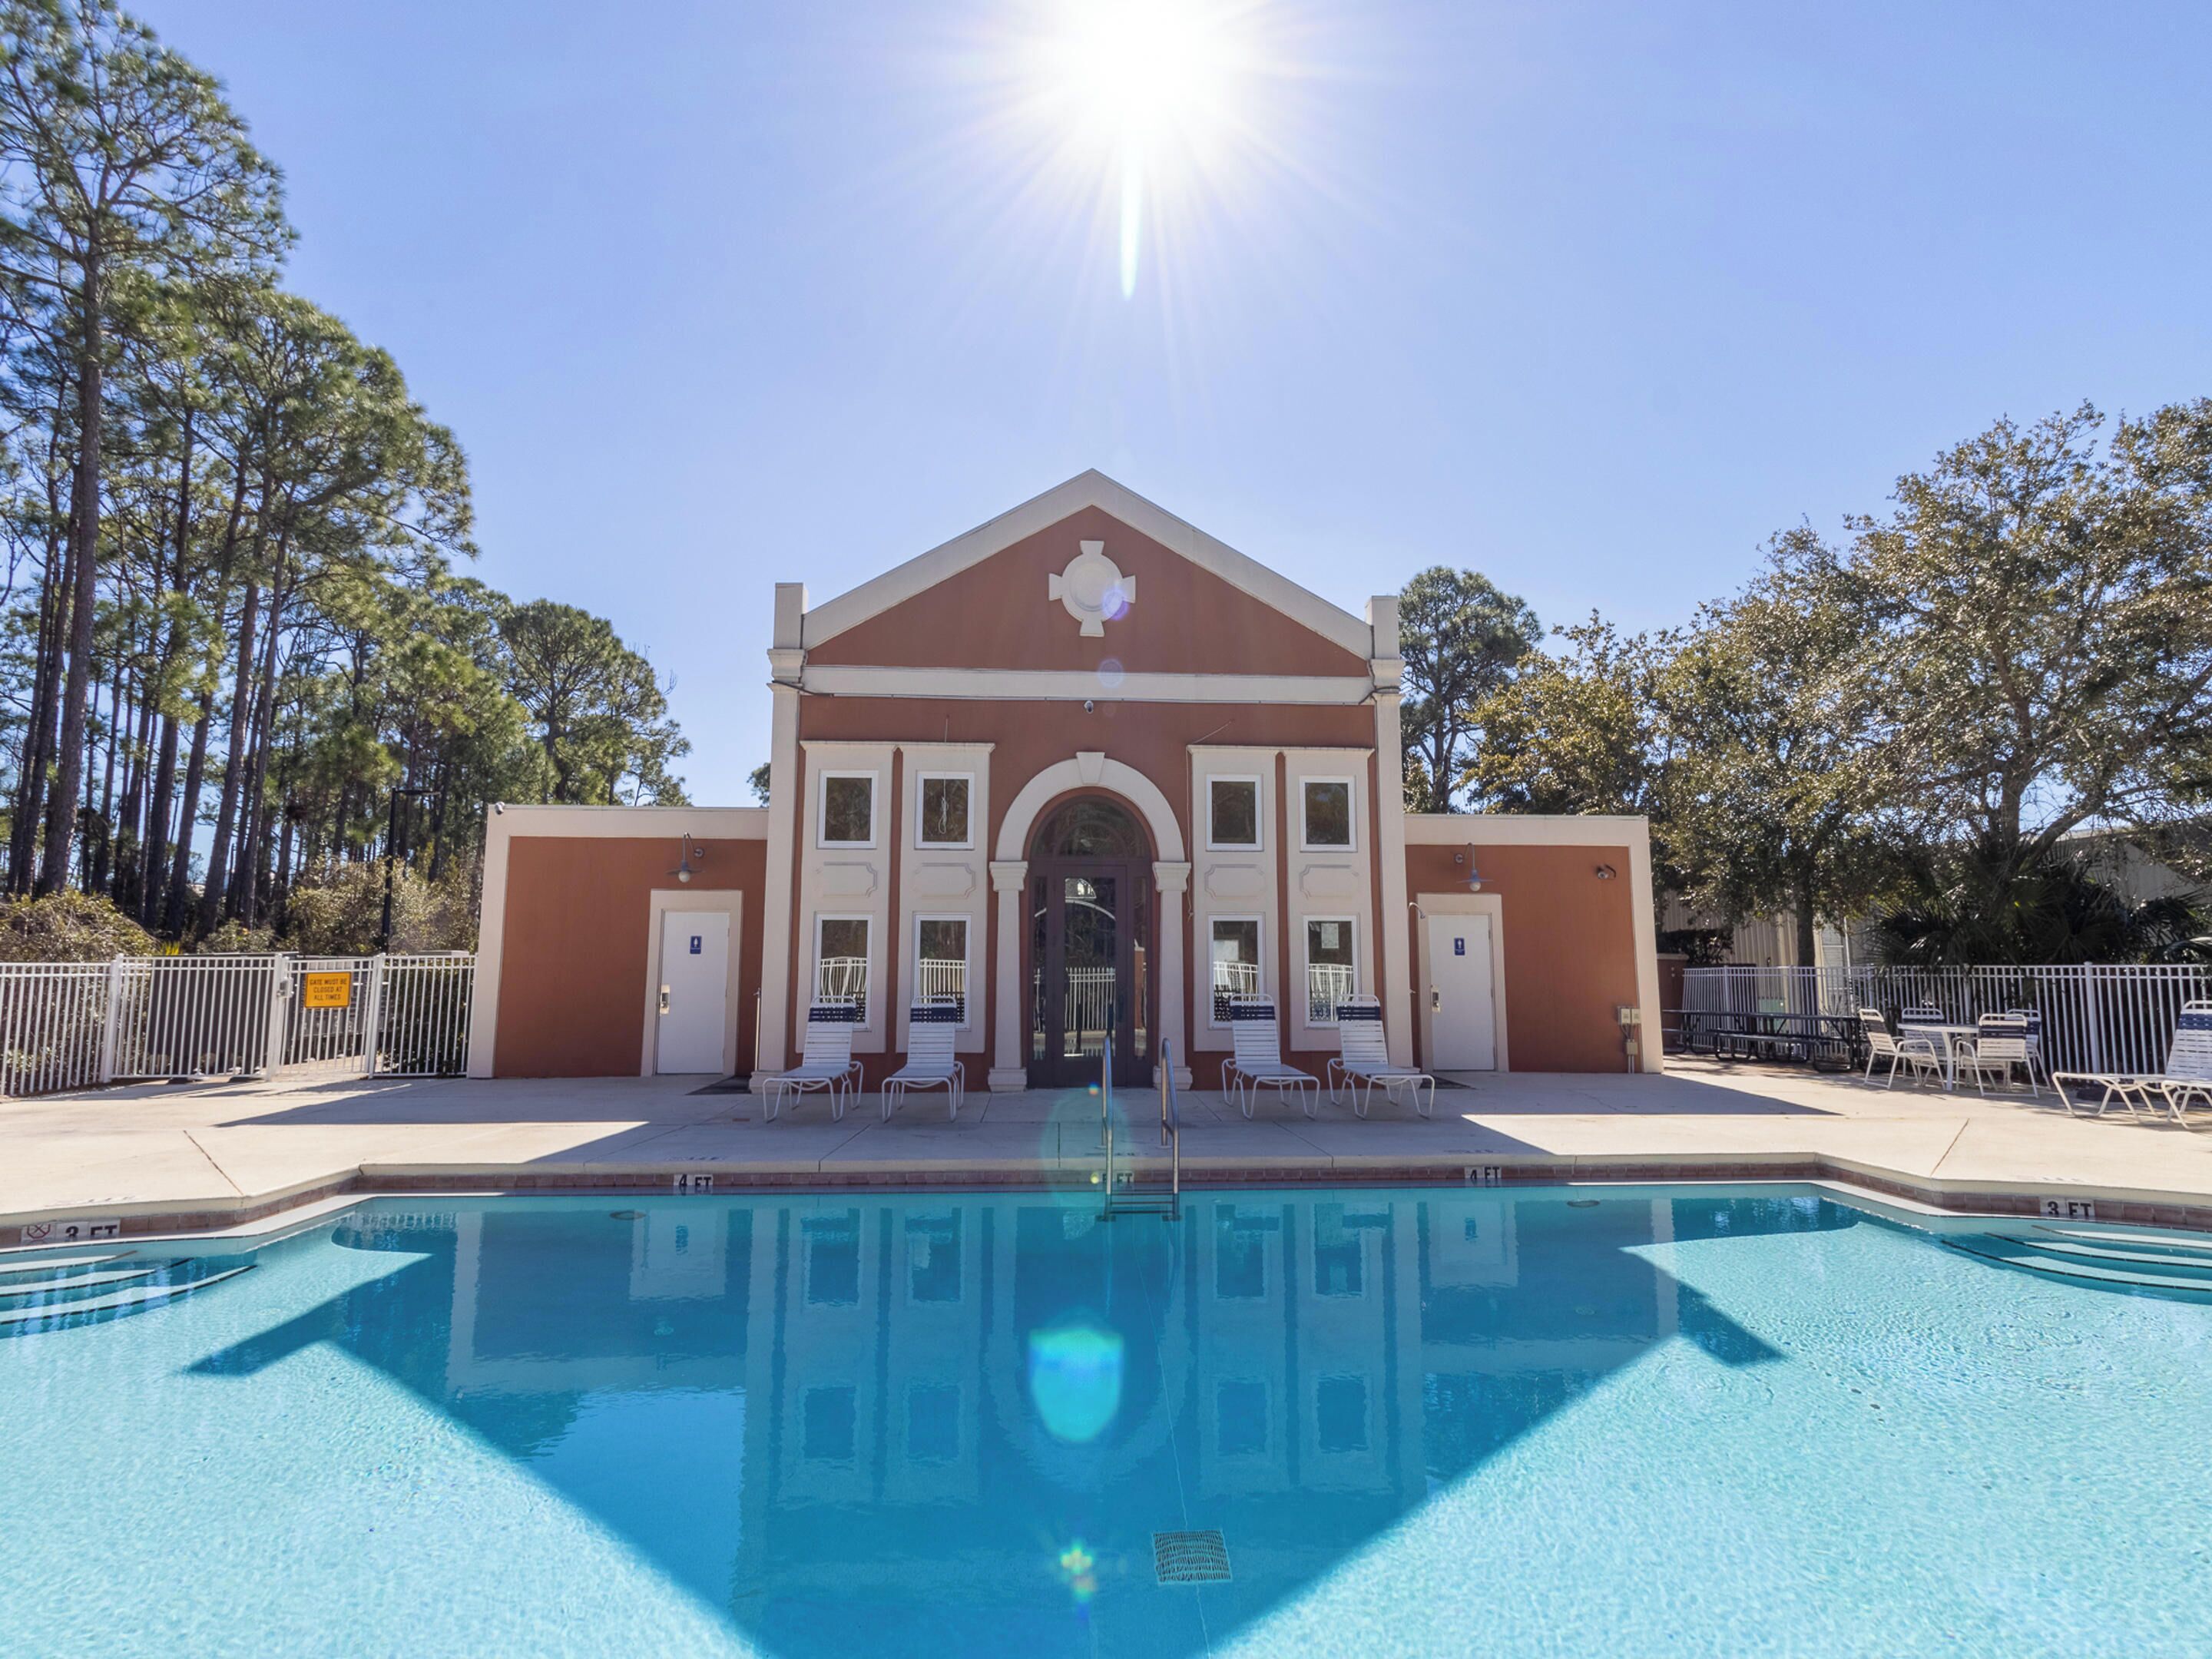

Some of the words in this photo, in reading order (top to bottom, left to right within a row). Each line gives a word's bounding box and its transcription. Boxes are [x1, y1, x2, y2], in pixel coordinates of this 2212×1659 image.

[1117, 1173, 1133, 1184] FT
[1484, 1167, 1500, 1180] FT
[678, 1174, 687, 1186] 4
[695, 1176, 712, 1186] FT
[2048, 1200, 2059, 1217] 3
[2068, 1201, 2091, 1217] FT
